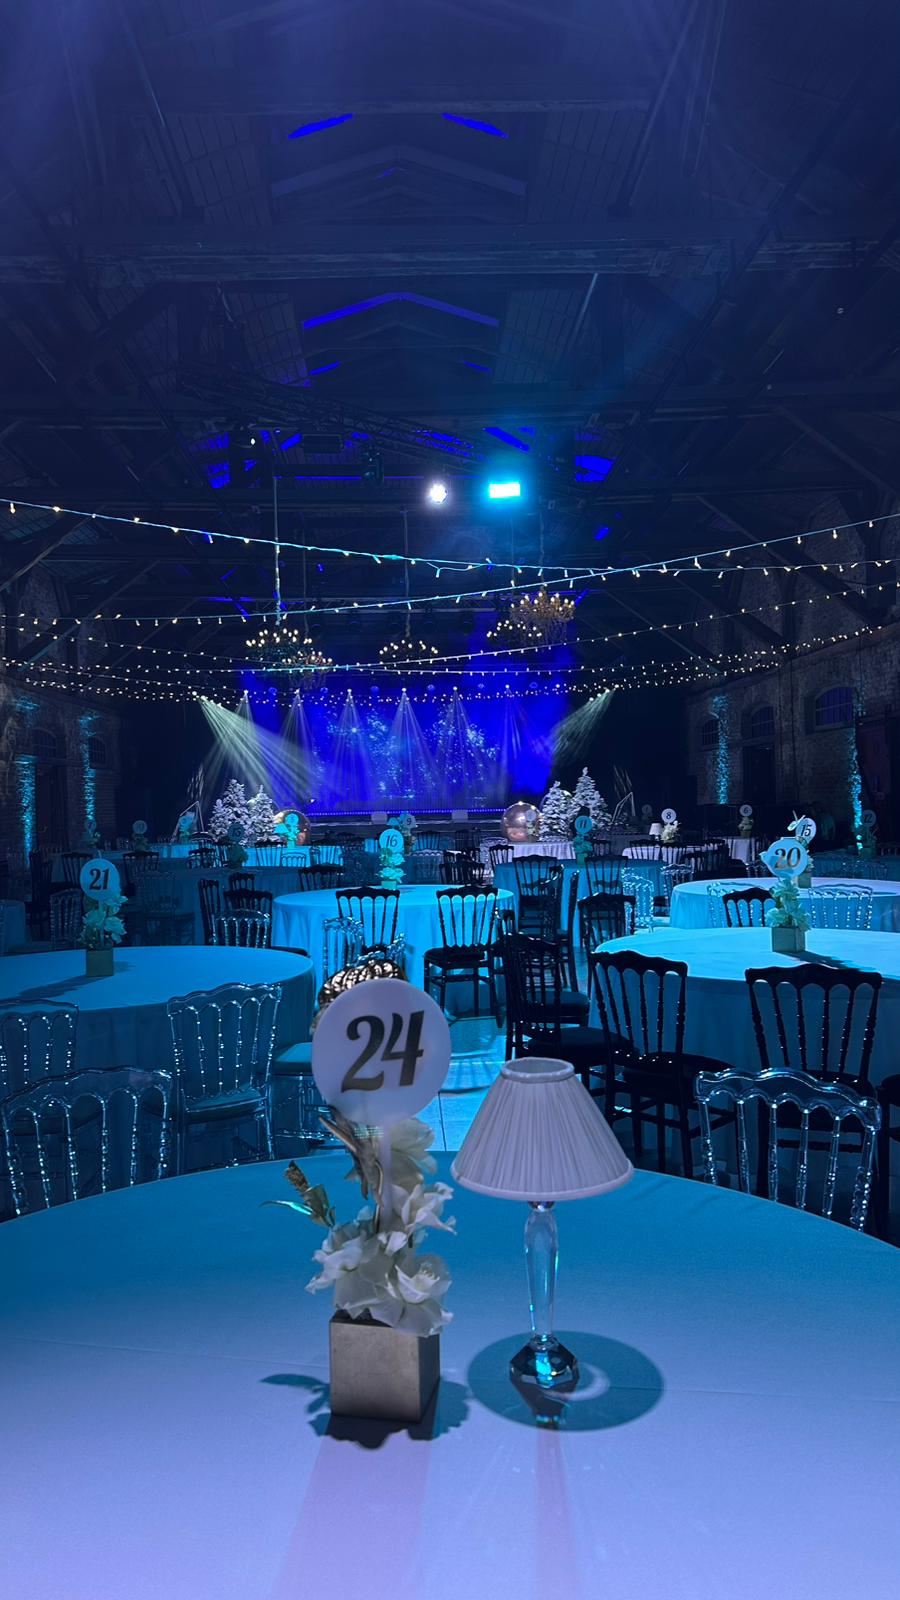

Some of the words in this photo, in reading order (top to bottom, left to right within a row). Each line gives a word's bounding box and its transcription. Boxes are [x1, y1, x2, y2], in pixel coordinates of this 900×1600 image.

[406, 817, 412, 826] 9
[666, 811, 672, 820] 8
[800, 824, 813, 837] 15
[386, 834, 398, 848] 16
[774, 847, 801, 869] 20
[89, 868, 110, 890] 21
[341, 1010, 424, 1093] 24
